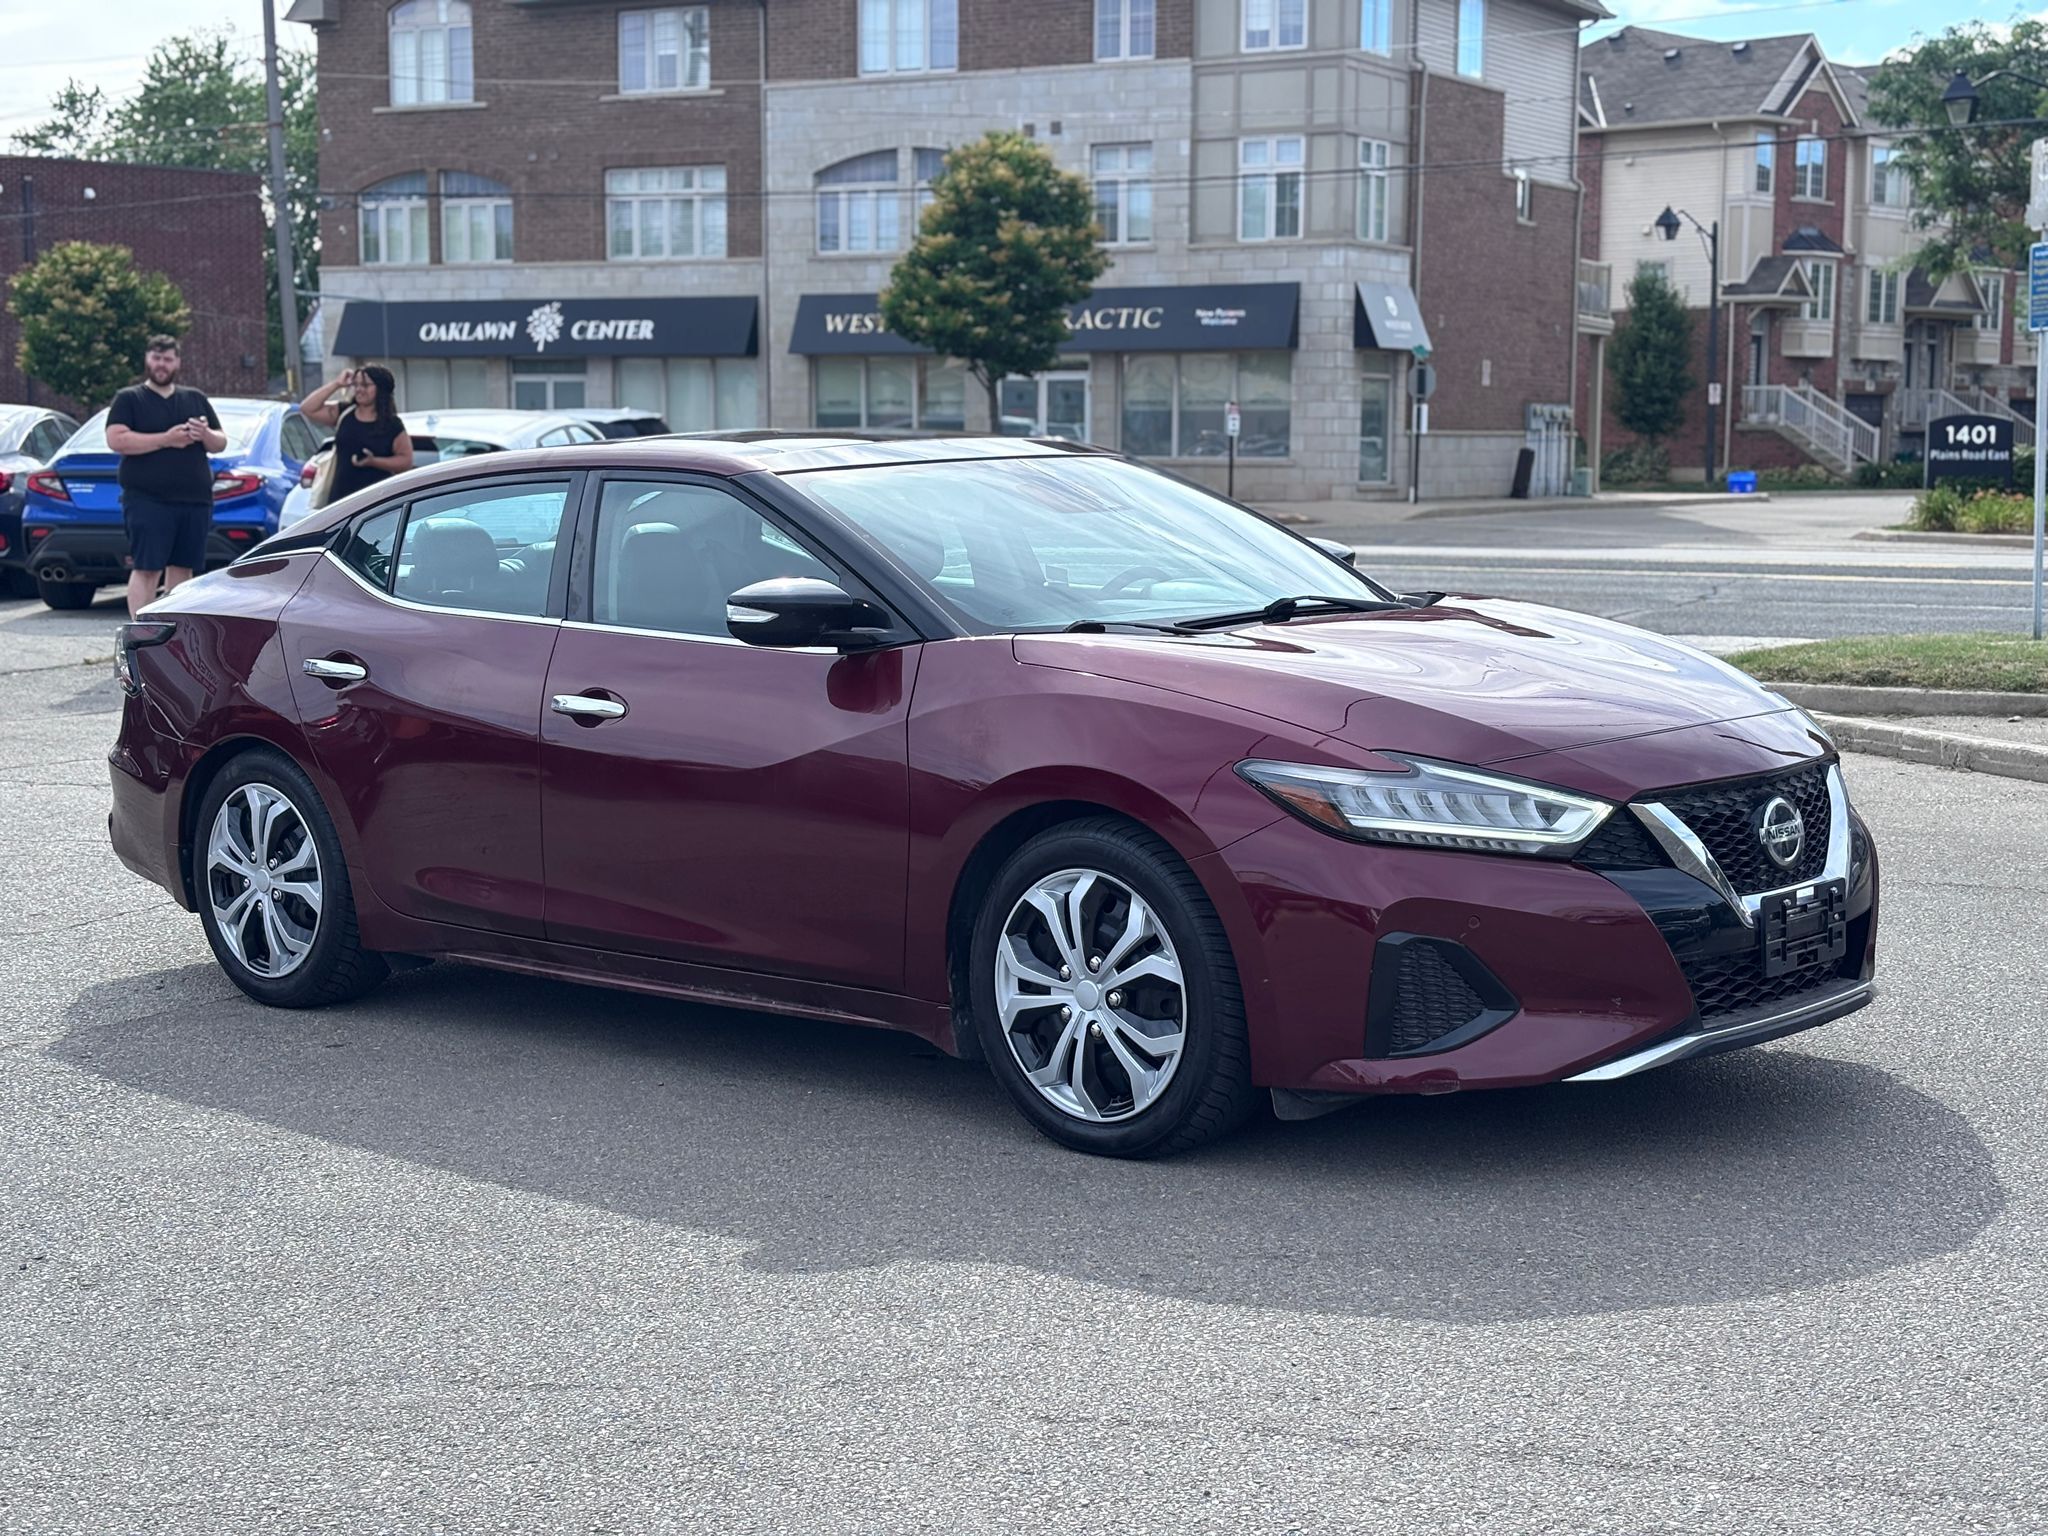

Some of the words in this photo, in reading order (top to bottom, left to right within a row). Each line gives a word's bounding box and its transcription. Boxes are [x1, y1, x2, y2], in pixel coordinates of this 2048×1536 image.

[418, 320, 518, 342] OAKLAWN
[570, 319, 655, 340] CENTER
[1945, 425, 1997, 445] 1401
[1929, 449, 1960, 460] Plains
[1961, 449, 1987, 460] Road
[1988, 449, 2010, 460] East
[1767, 823, 1801, 841] NISSAN
